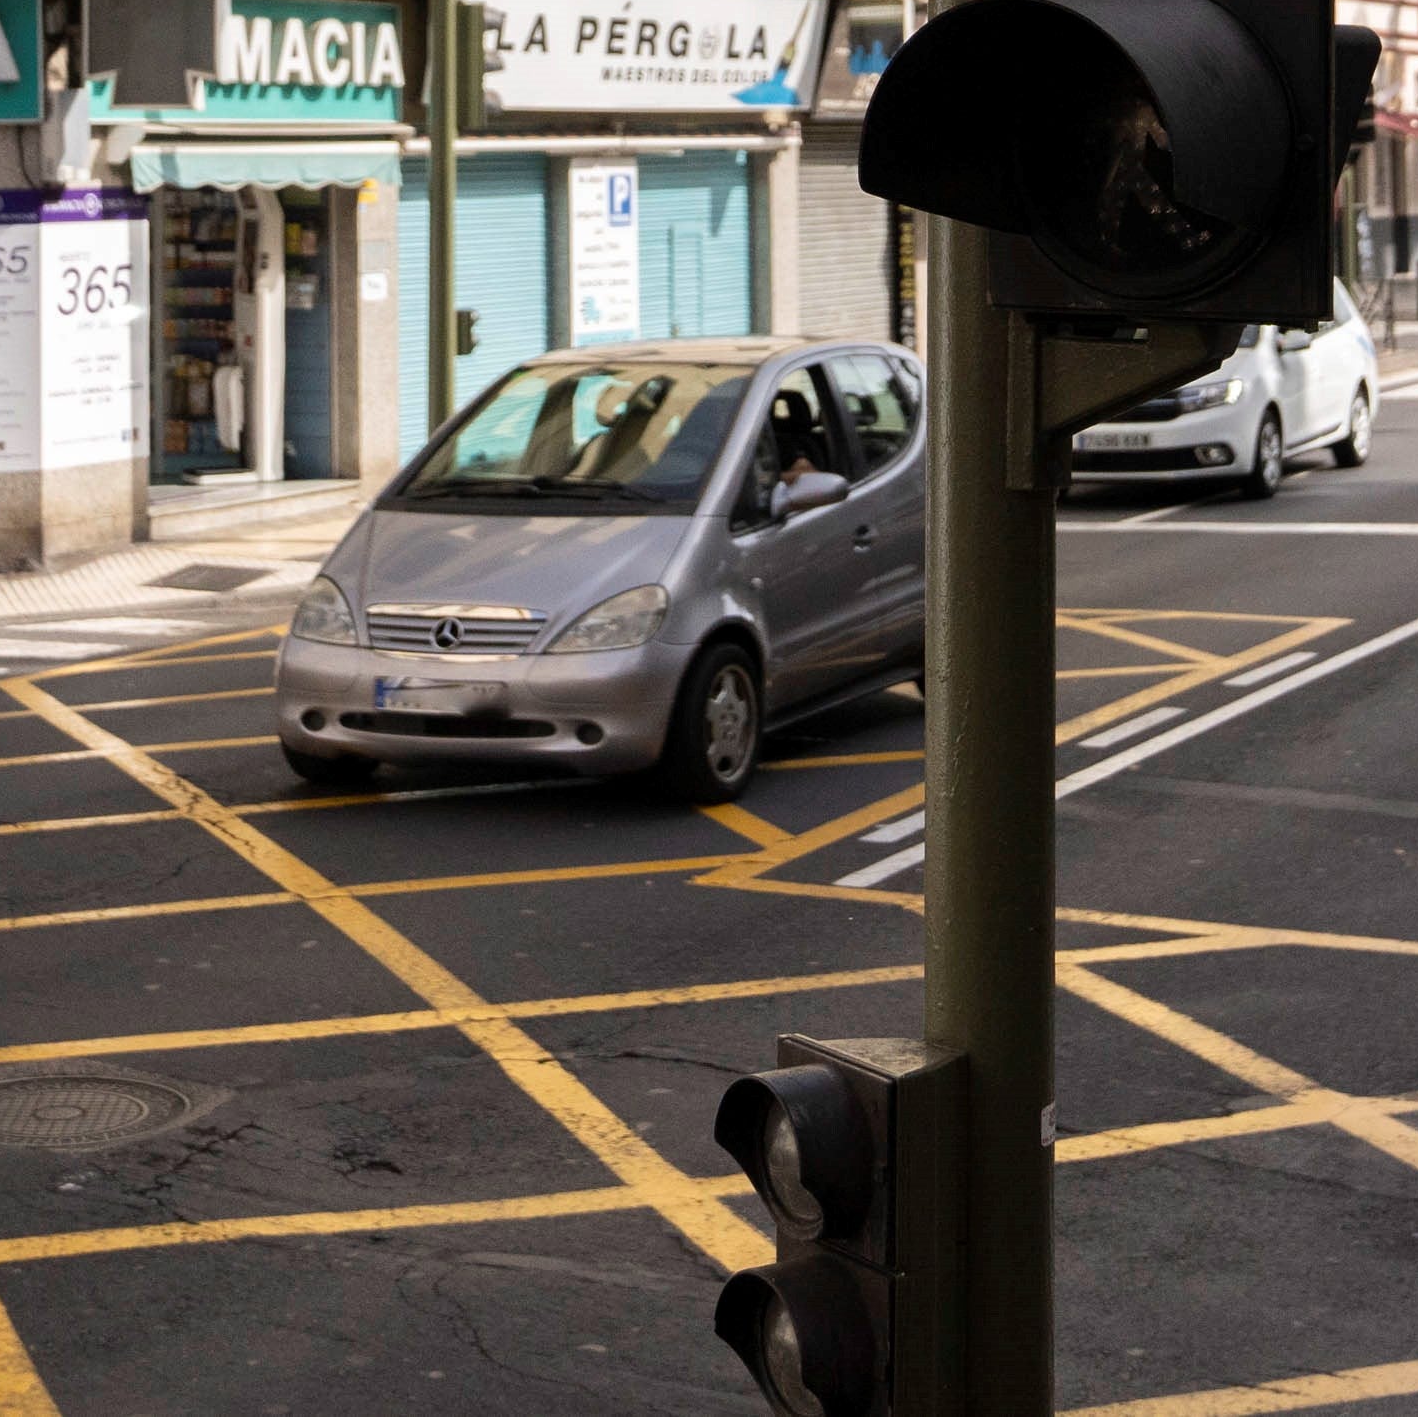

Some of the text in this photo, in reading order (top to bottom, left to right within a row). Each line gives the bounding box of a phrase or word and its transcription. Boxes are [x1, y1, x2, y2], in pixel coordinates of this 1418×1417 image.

[217, 13, 405, 88] MACIA
[496, 12, 549, 53] LA
[57, 263, 134, 317] 365
